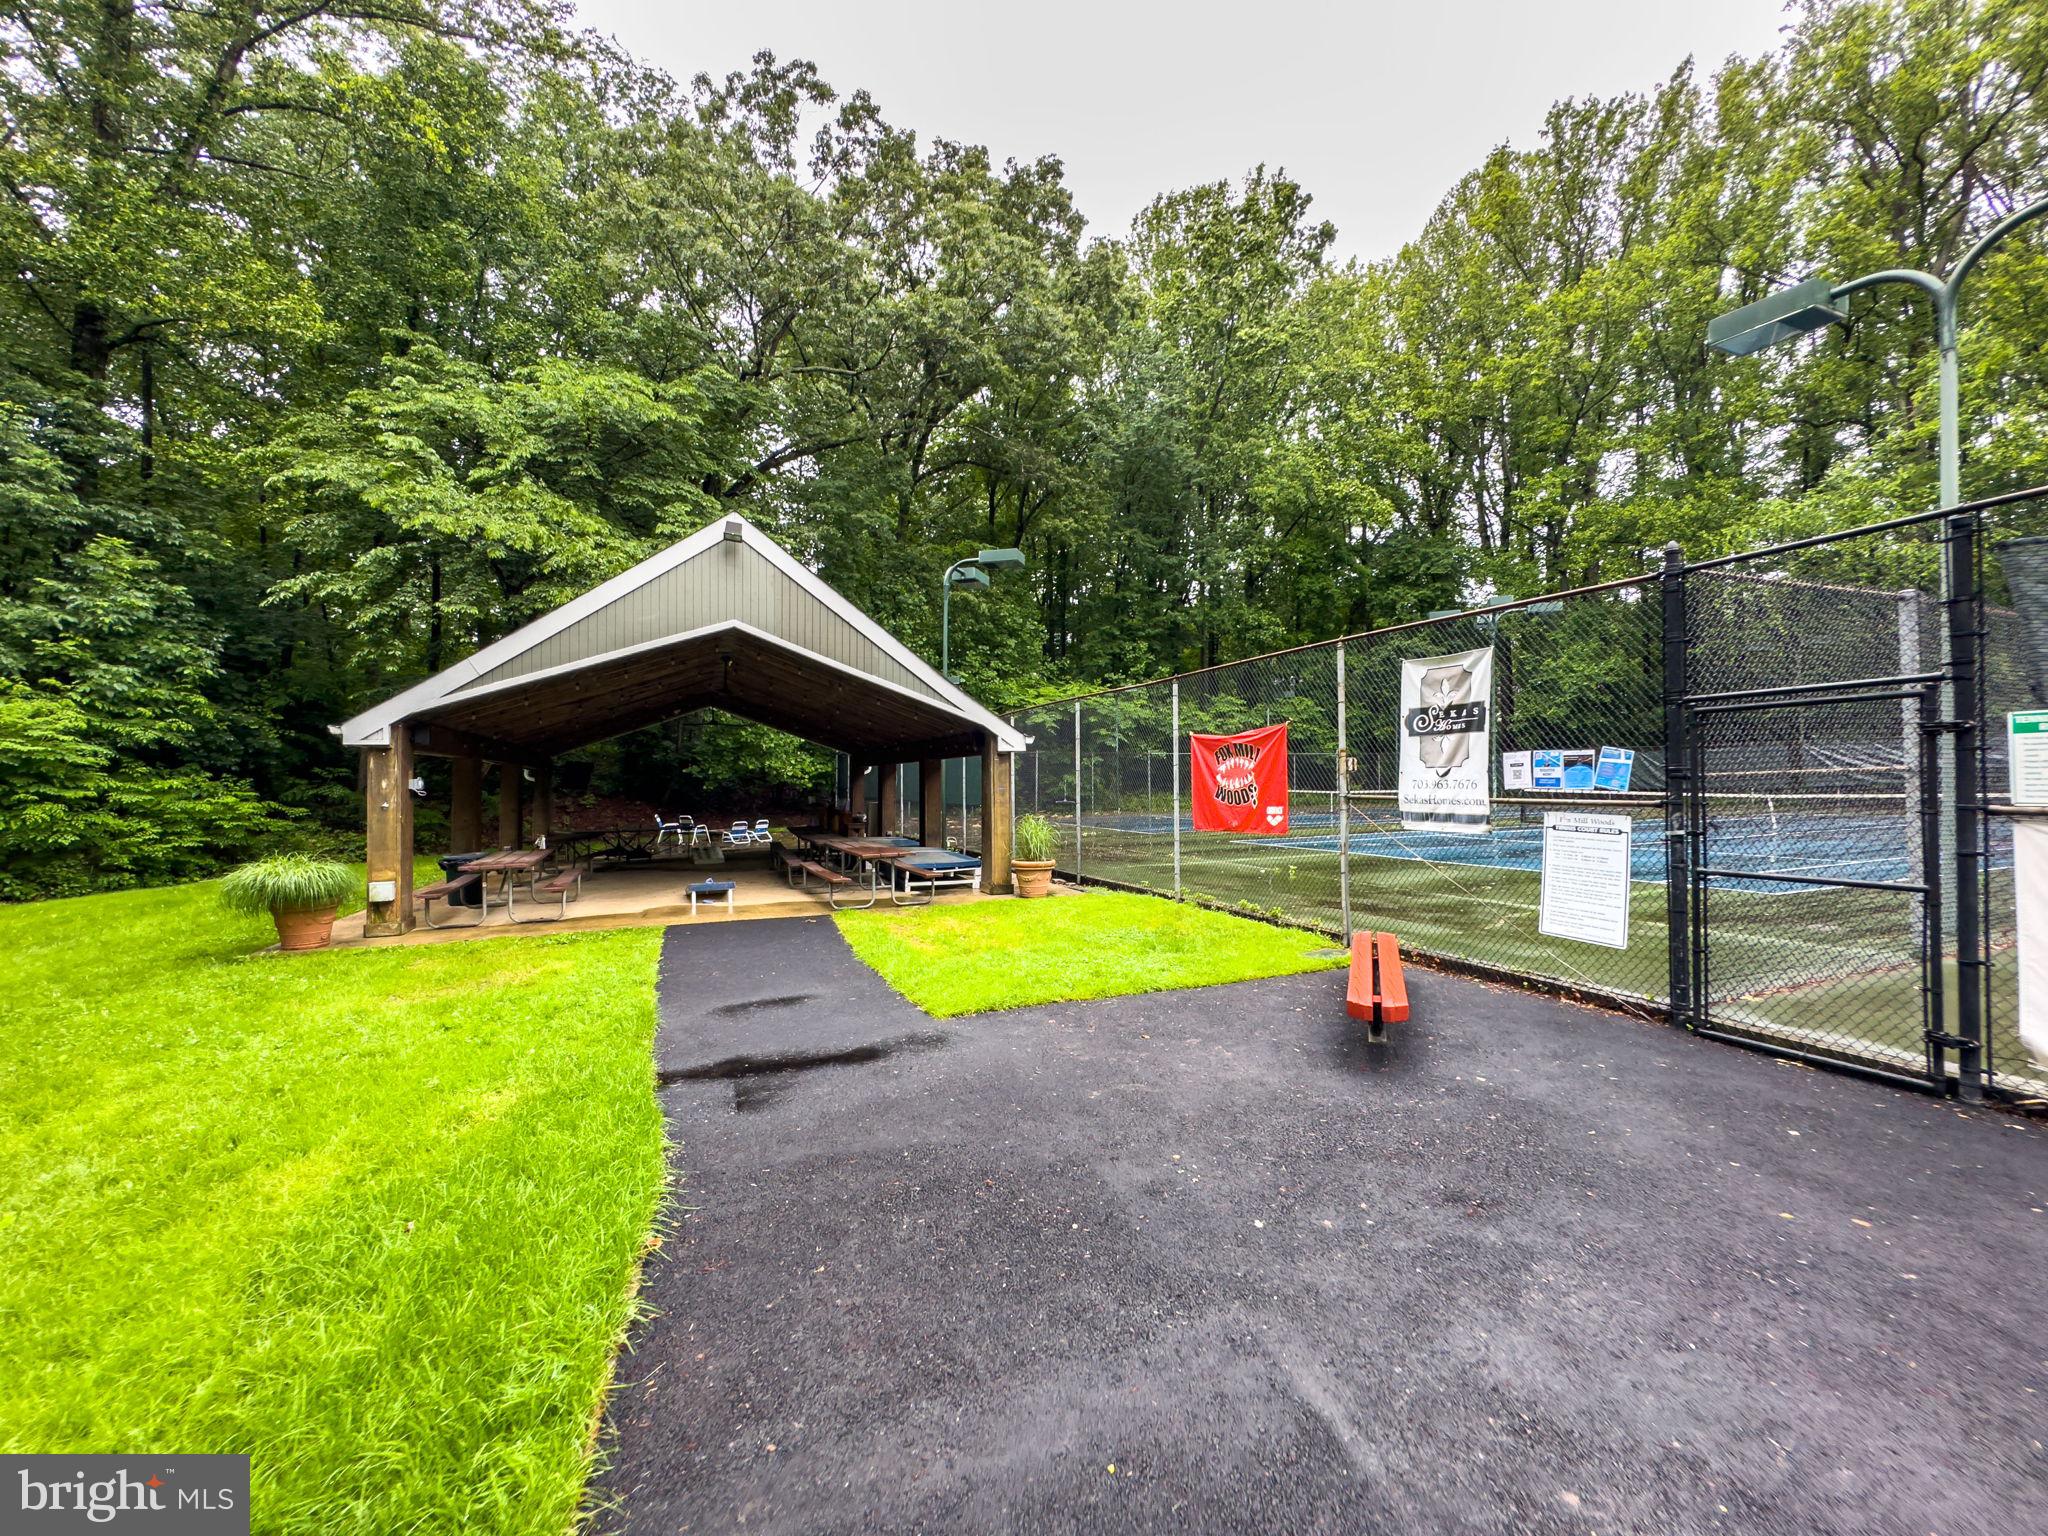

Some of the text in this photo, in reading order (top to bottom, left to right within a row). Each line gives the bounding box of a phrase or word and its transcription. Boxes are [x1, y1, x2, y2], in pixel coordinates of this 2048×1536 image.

[1214, 742, 1261, 765] FOX MILL
[1412, 779, 1478, 790] 703.963.7676
[1214, 783, 1258, 806] WOODS
[1403, 794, 1486, 806] SekasHomes.com
[1590, 818, 1615, 826] Woods
[1577, 826, 1599, 834] COURT
